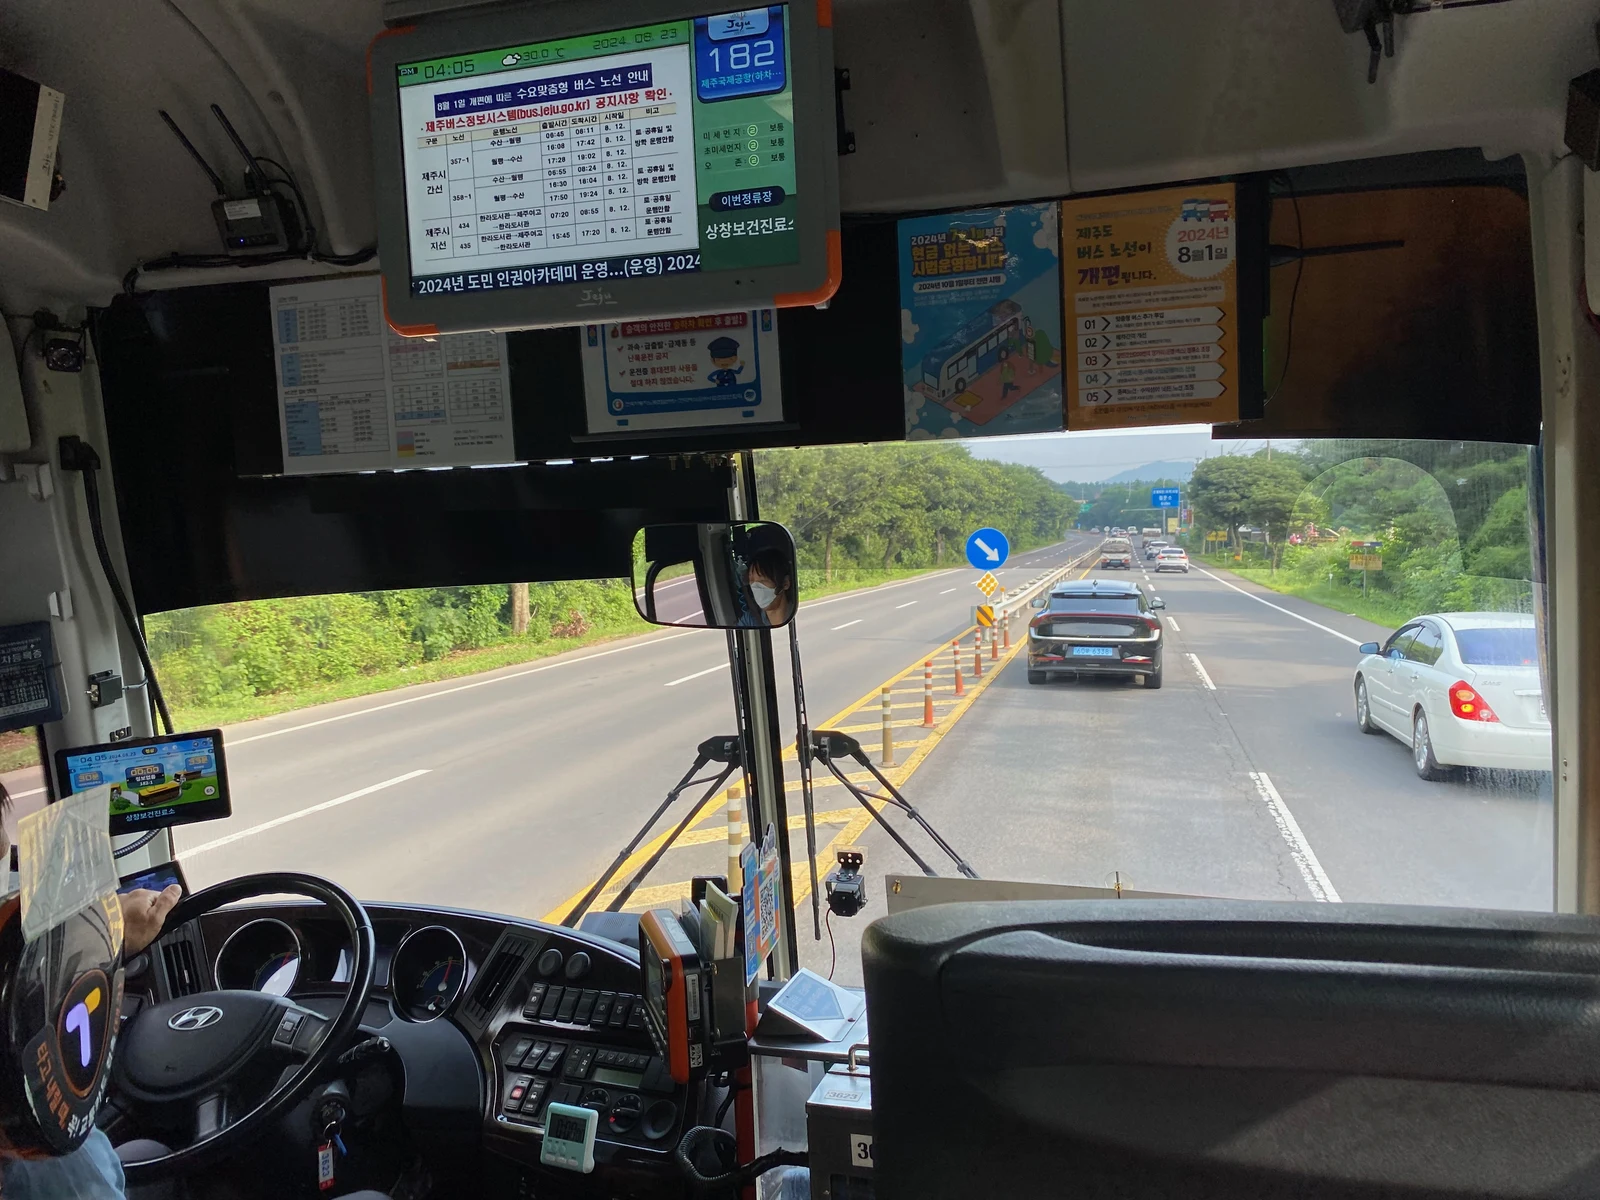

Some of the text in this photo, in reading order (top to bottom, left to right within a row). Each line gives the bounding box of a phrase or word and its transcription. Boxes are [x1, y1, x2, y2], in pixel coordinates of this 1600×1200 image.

[661, 28, 677, 39] 23
[523, 48, 549, 61] 30.0
[709, 40, 774, 72] 182
[425, 60, 474, 78] 04:05
[438, 70, 648, 111] 8월 1일 개편에 따른 수요맞춤형 버스 노선 안내
[596, 92, 639, 108] 공지사항
[493, 126, 518, 136] 운행노선
[542, 120, 568, 129] 출발시간
[572, 116, 597, 125] 도착시간
[605, 112, 624, 120] 시작일
[770, 123, 784, 131] 보통
[771, 138, 785, 146] 보통
[451, 157, 469, 165] 357-1
[771, 153, 785, 161] 보통
[422, 170, 446, 180] 제주시
[427, 185, 443, 195] 간선
[722, 191, 772, 206] 이번정류장
[426, 227, 450, 237] 제주시
[1076, 225, 1112, 239] 제주도
[1177, 227, 1229, 242] 2024년
[911, 233, 946, 245] 2024년
[431, 241, 446, 250] 지선
[1077, 242, 1151, 259] 버스 노선이
[912, 246, 938, 260] 현금
[944, 243, 970, 257] 없는
[913, 254, 1004, 276] 시범운영합니다
[419, 276, 464, 293] 2024년
[468, 273, 493, 289] 도민
[497, 264, 577, 288] 인권아카데미
[918, 282, 940, 290] 2024년
[581, 287, 612, 304] Jeju
[626, 324, 648, 334] 승객의
[649, 321, 671, 332] 안전한
[673, 319, 695, 329] 승하차
[1085, 320, 1095, 329] 01
[1085, 338, 1097, 348] 02
[1086, 356, 1097, 366] 03
[629, 368, 648, 376] 운전중
[1086, 374, 1098, 384] 04
[1087, 392, 1098, 402] 05
